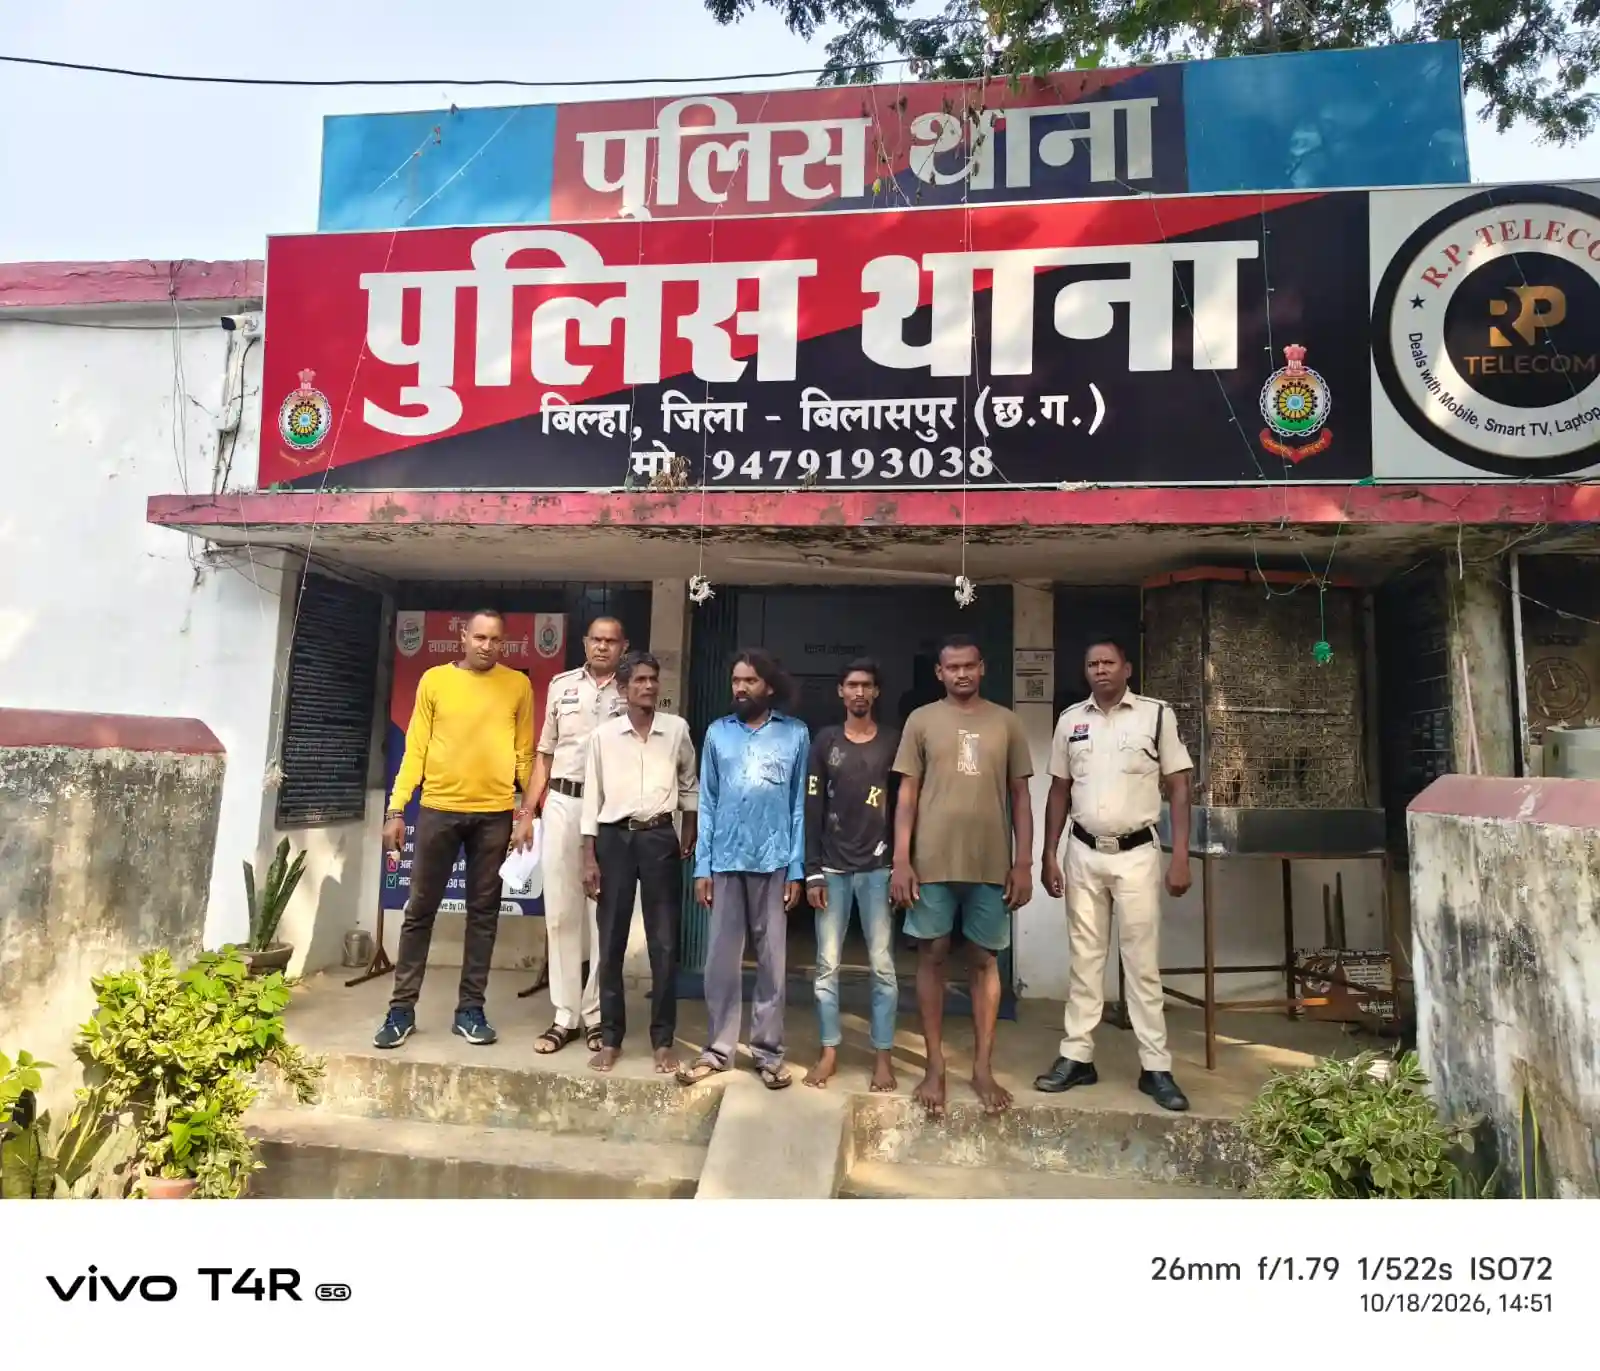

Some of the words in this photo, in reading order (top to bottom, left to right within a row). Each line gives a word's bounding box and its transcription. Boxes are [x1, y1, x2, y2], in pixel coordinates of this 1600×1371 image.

[910, 97, 1158, 190] थाना
[1421, 243, 1474, 289] R.P.
[360, 230, 817, 436] पुलिस
[860, 239, 1259, 377] थाना
[1408, 332, 1427, 369] Deals
[1420, 369, 1441, 396] with
[1438, 391, 1480, 429] Mobile,
[1484, 417, 1526, 437] Smart
[1529, 422, 1553, 437] TV,
[1463, 354, 1597, 376] TELECOM
[540, 391, 643, 440] बिल्हा,
[661, 392, 747, 433] जिला
[800, 387, 956, 442] बिलासपुर
[711, 445, 993, 480] 9479193038
[808, 775, 819, 795] E
[865, 786, 882, 807] K
